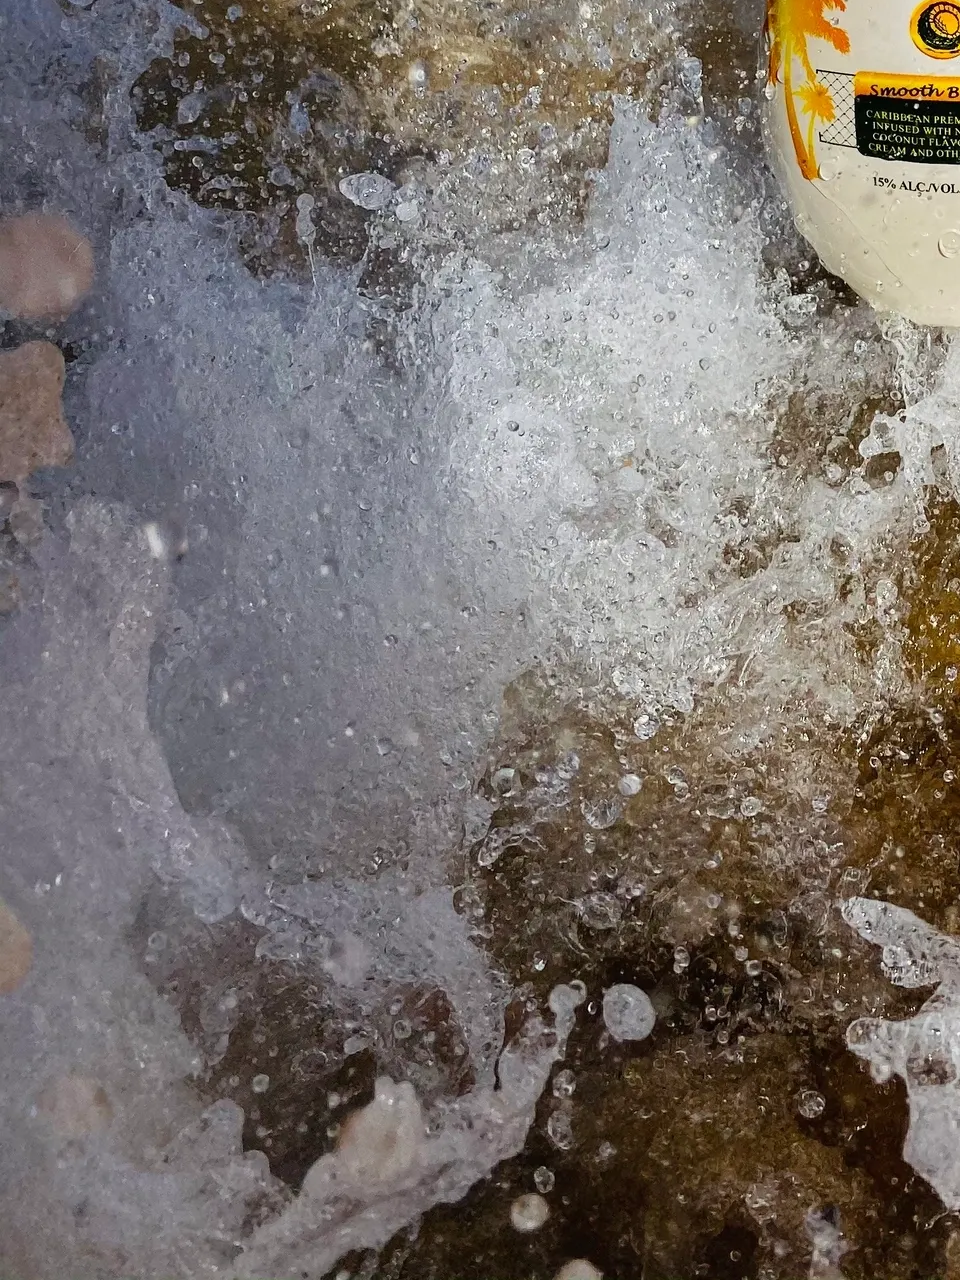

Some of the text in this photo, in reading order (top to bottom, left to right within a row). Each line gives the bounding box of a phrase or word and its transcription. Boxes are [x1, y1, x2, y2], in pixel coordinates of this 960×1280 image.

[869, 84, 944, 98] Smooth
[866, 110, 930, 124] CARIBBEAN
[873, 122, 920, 135] INFUSED
[923, 126, 951, 136] WITH
[873, 132, 926, 146] COCONUT
[868, 142, 907, 156] CREAM
[911, 149, 934, 157] AND
[872, 176, 897, 190] 15%
